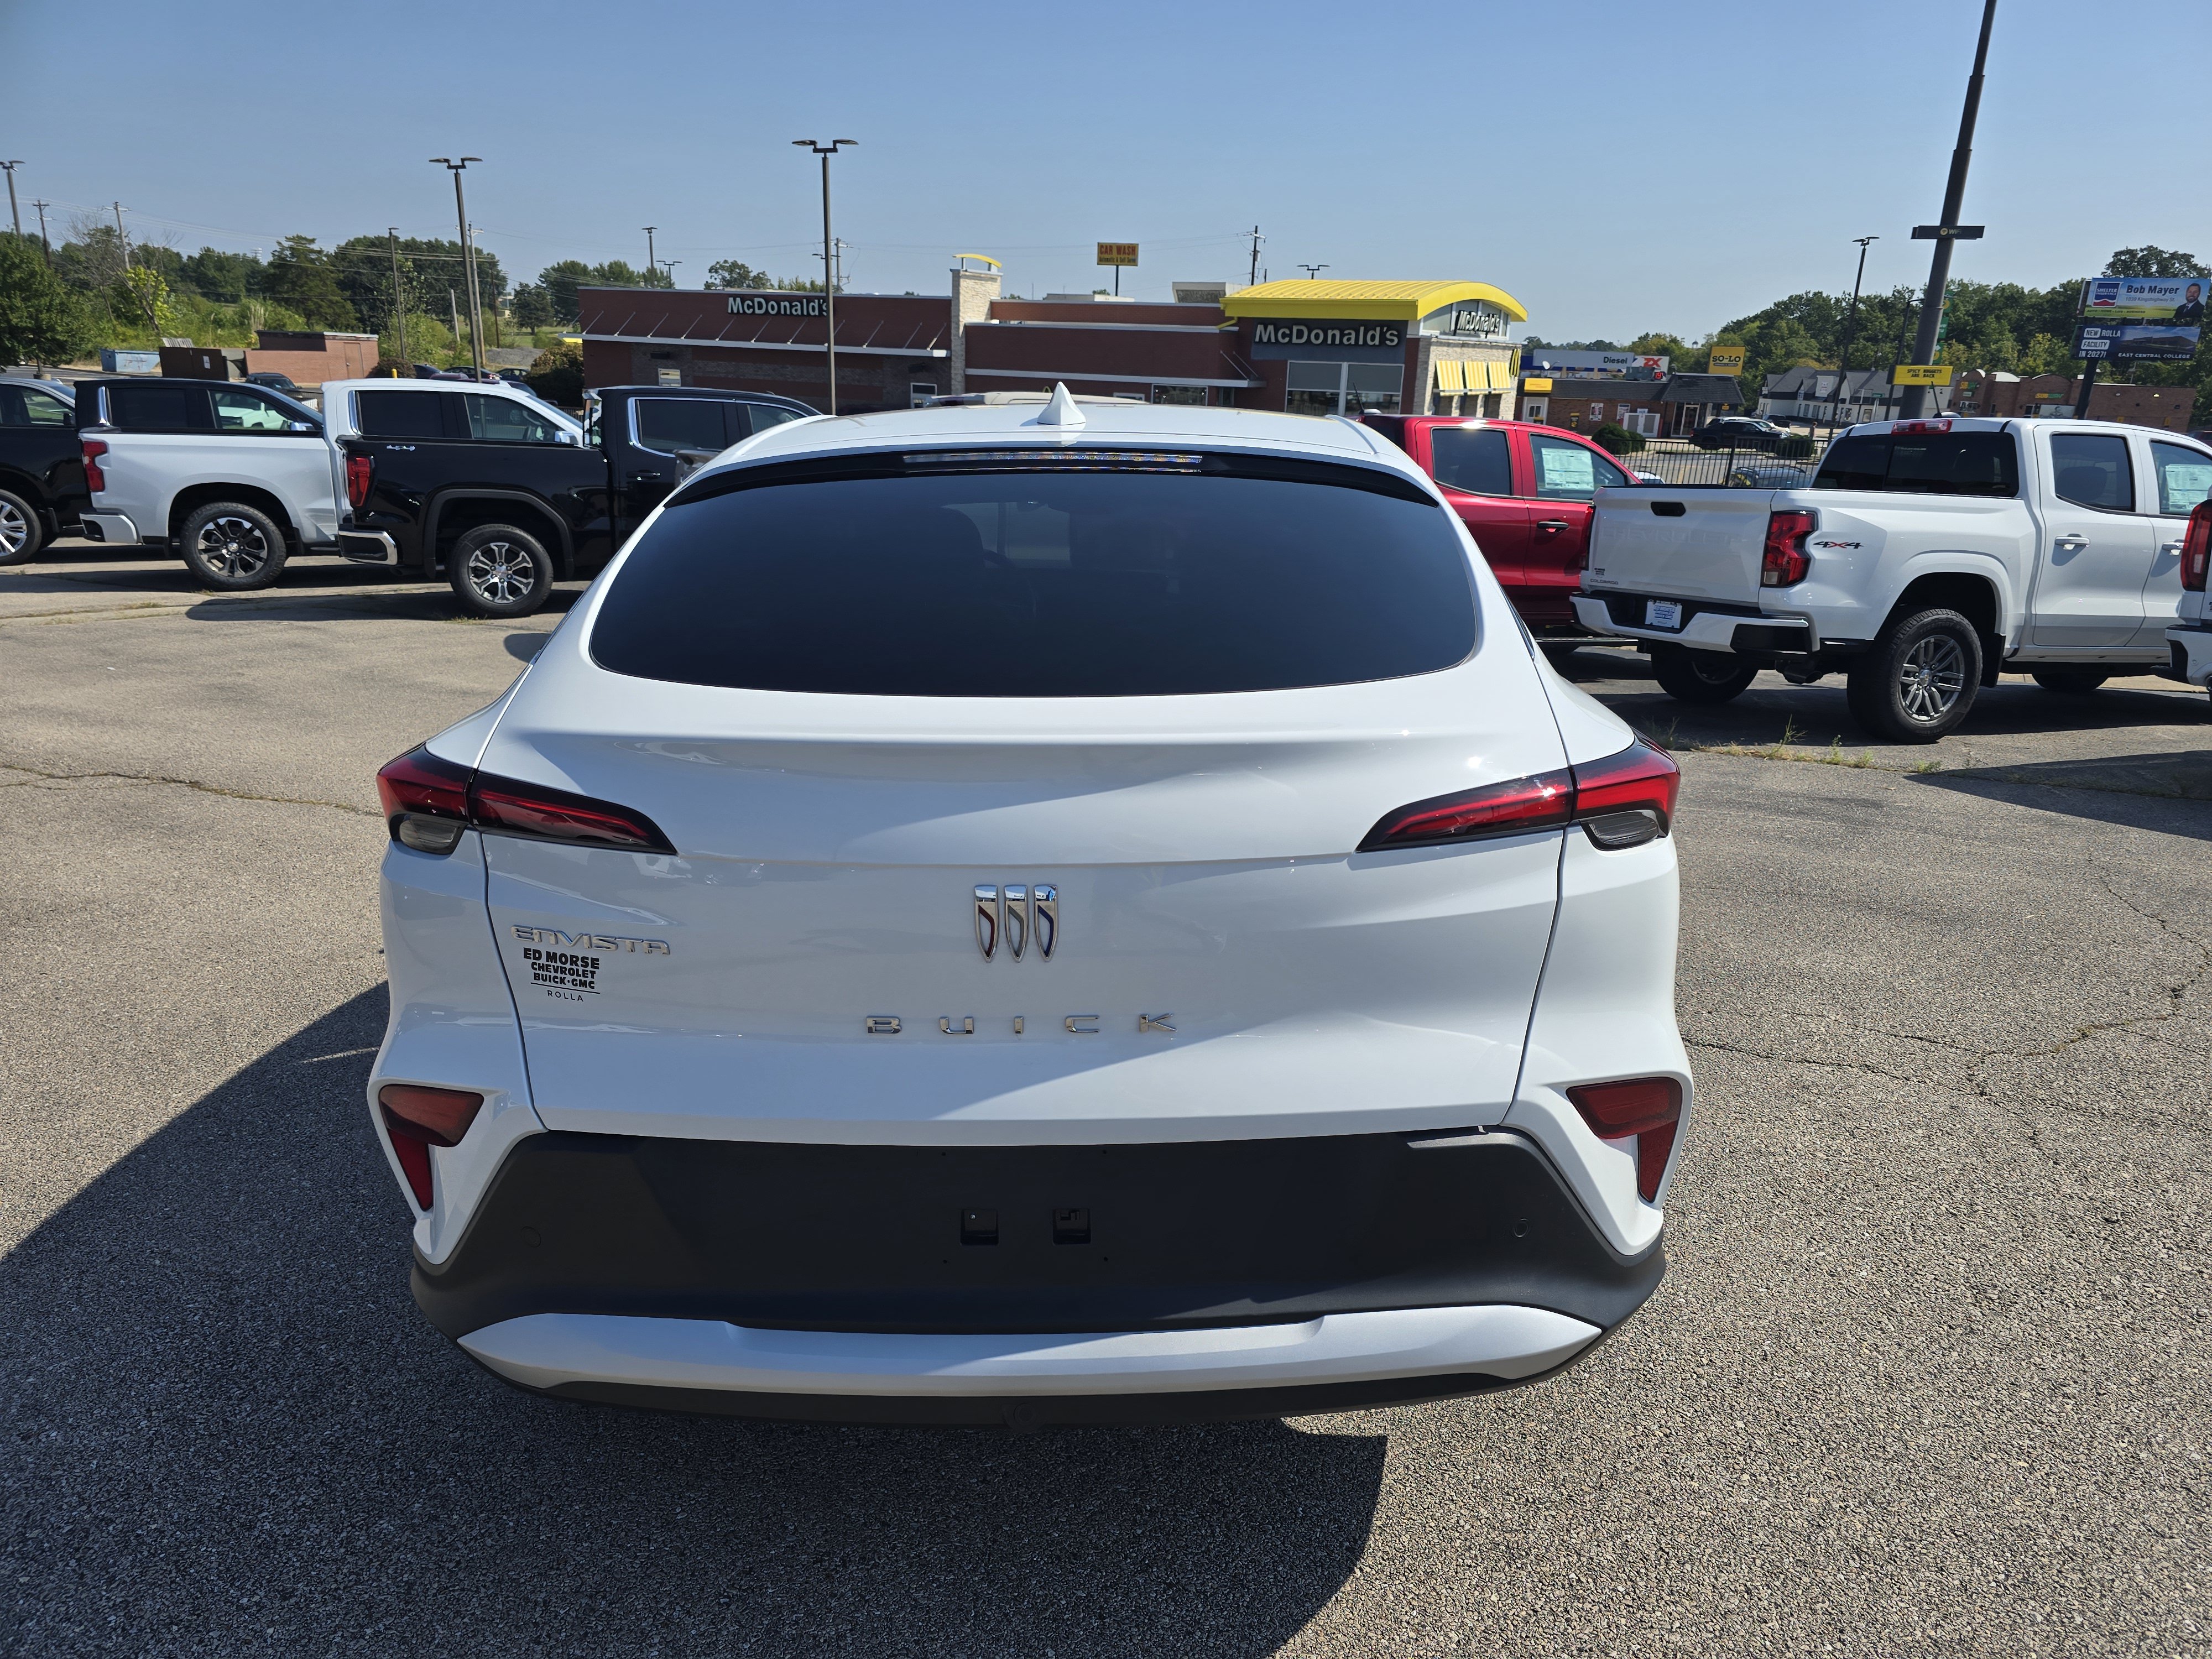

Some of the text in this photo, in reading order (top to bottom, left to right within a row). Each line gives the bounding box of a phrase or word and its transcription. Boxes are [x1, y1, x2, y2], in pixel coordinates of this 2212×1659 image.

[1100, 244, 1136, 256] CAR WASH
[2126, 285, 2179, 295] Bob Mayer
[1457, 310, 1500, 332] McDonald's
[1254, 324, 1399, 346] McDonald's
[510, 924, 671, 956] ENVISTA
[523, 947, 599, 970] ED MORSE
[531, 961, 596, 979] CHEVROLET
[547, 989, 584, 1002] ROLLA
[866, 1013, 1177, 1034] BUICK
